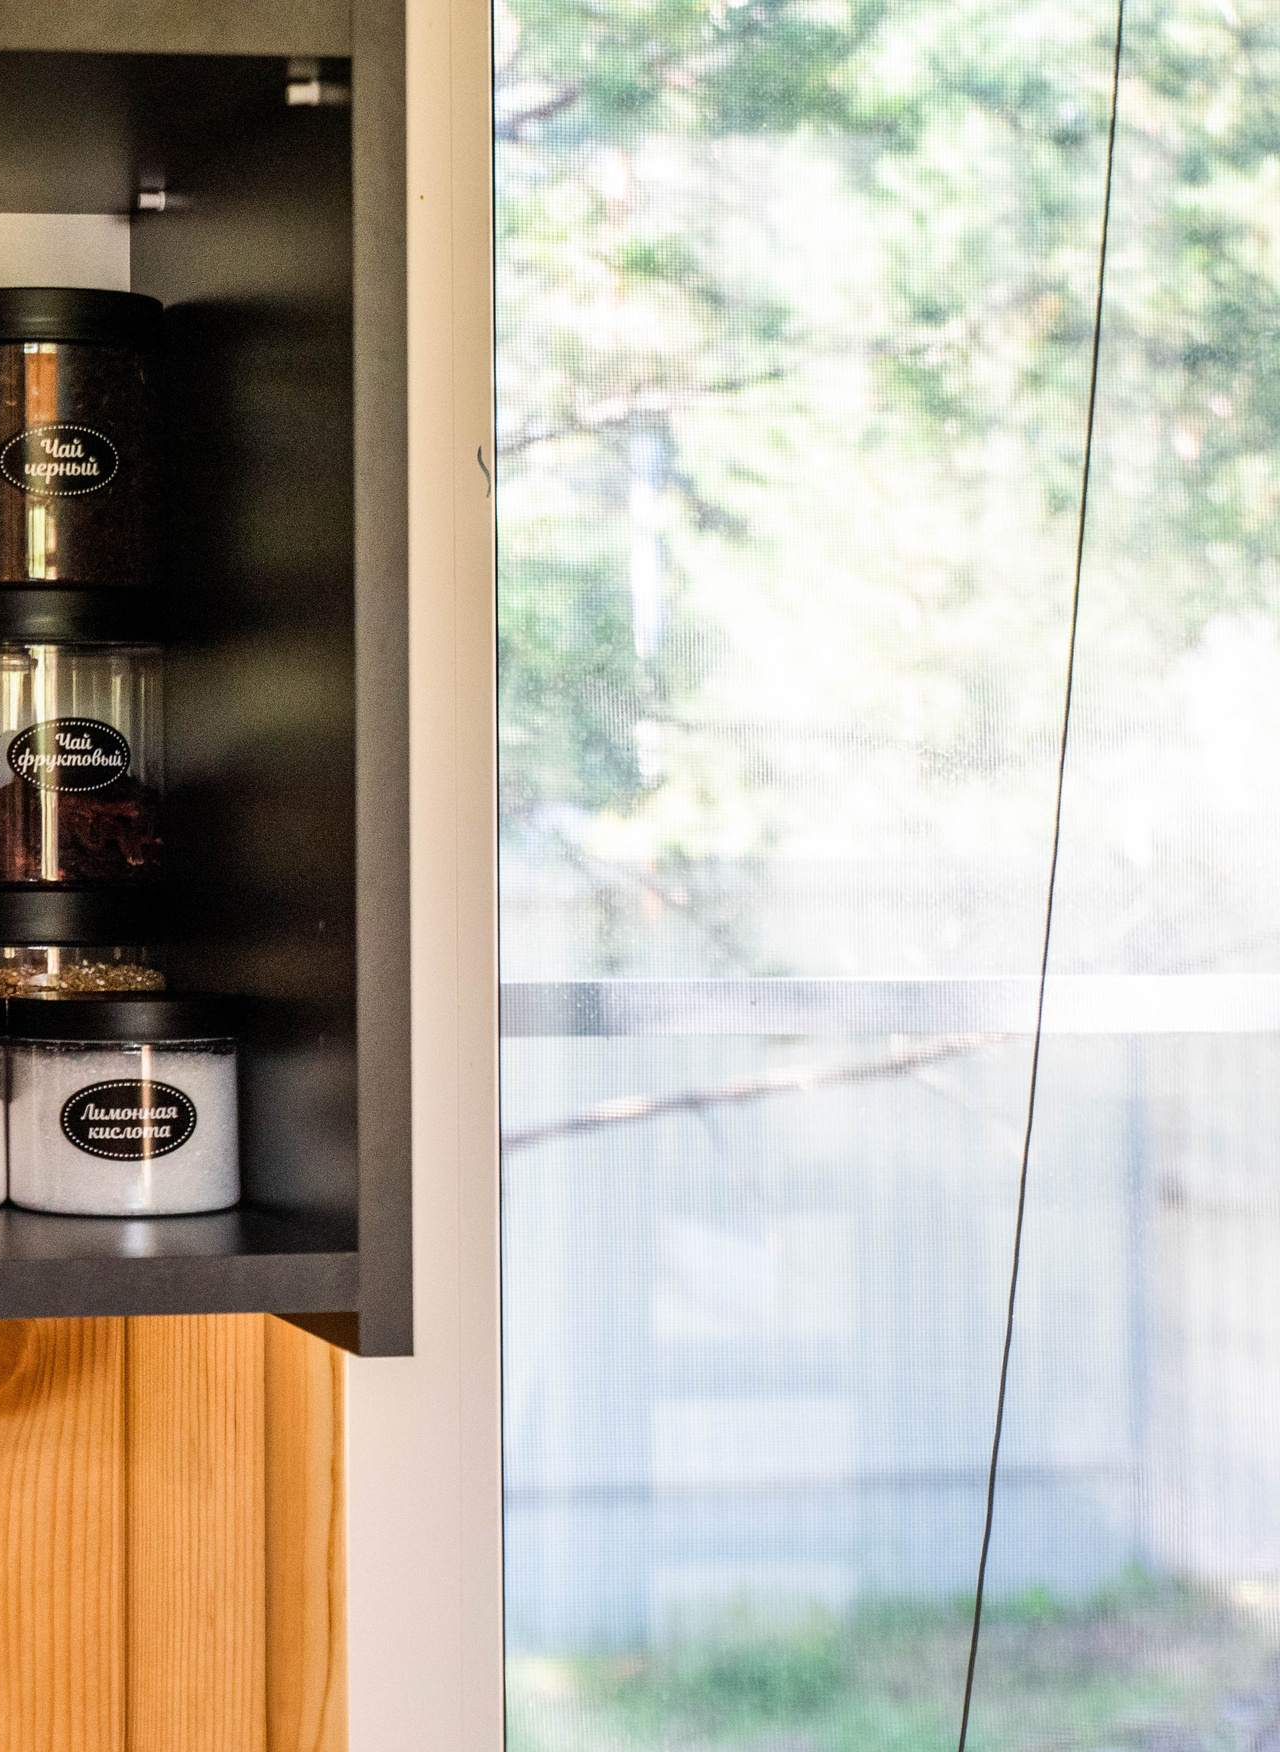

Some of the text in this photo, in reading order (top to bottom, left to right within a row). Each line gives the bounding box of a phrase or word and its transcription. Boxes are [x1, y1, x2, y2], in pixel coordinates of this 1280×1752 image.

[40, 438, 85, 458] Чай
[24, 456, 100, 485] черный
[54, 732, 93, 751] Чай
[17, 748, 123, 773] фруктовый
[80, 1102, 179, 1121] Лимонная
[87, 1123, 172, 1140] кислота
